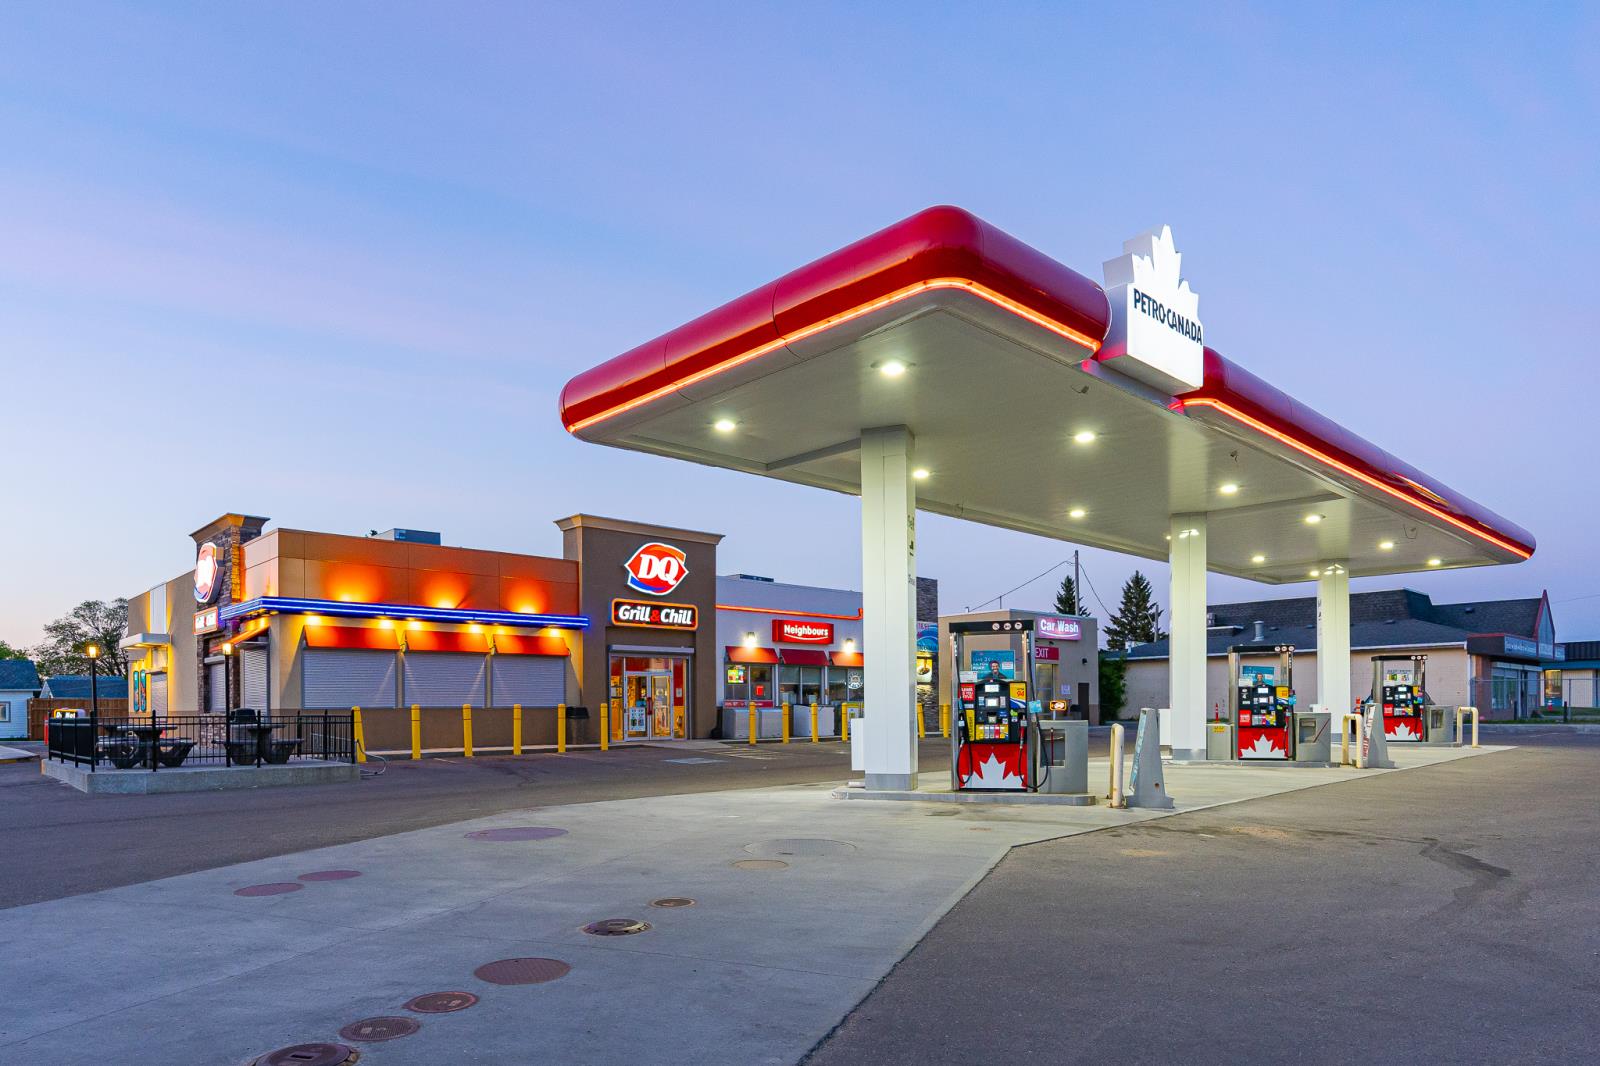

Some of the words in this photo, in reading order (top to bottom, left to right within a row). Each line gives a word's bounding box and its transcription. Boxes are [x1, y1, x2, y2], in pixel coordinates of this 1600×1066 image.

[638, 554, 679, 585] DQ
[618, 605, 651, 622] Grill
[651, 609, 660, 622] &
[660, 608, 692, 625] Chill
[784, 624, 828, 636] Neighbours
[1040, 618, 1056, 632] Car
[1057, 619, 1079, 633] Wash
[1035, 647, 1049, 659] EXIT
